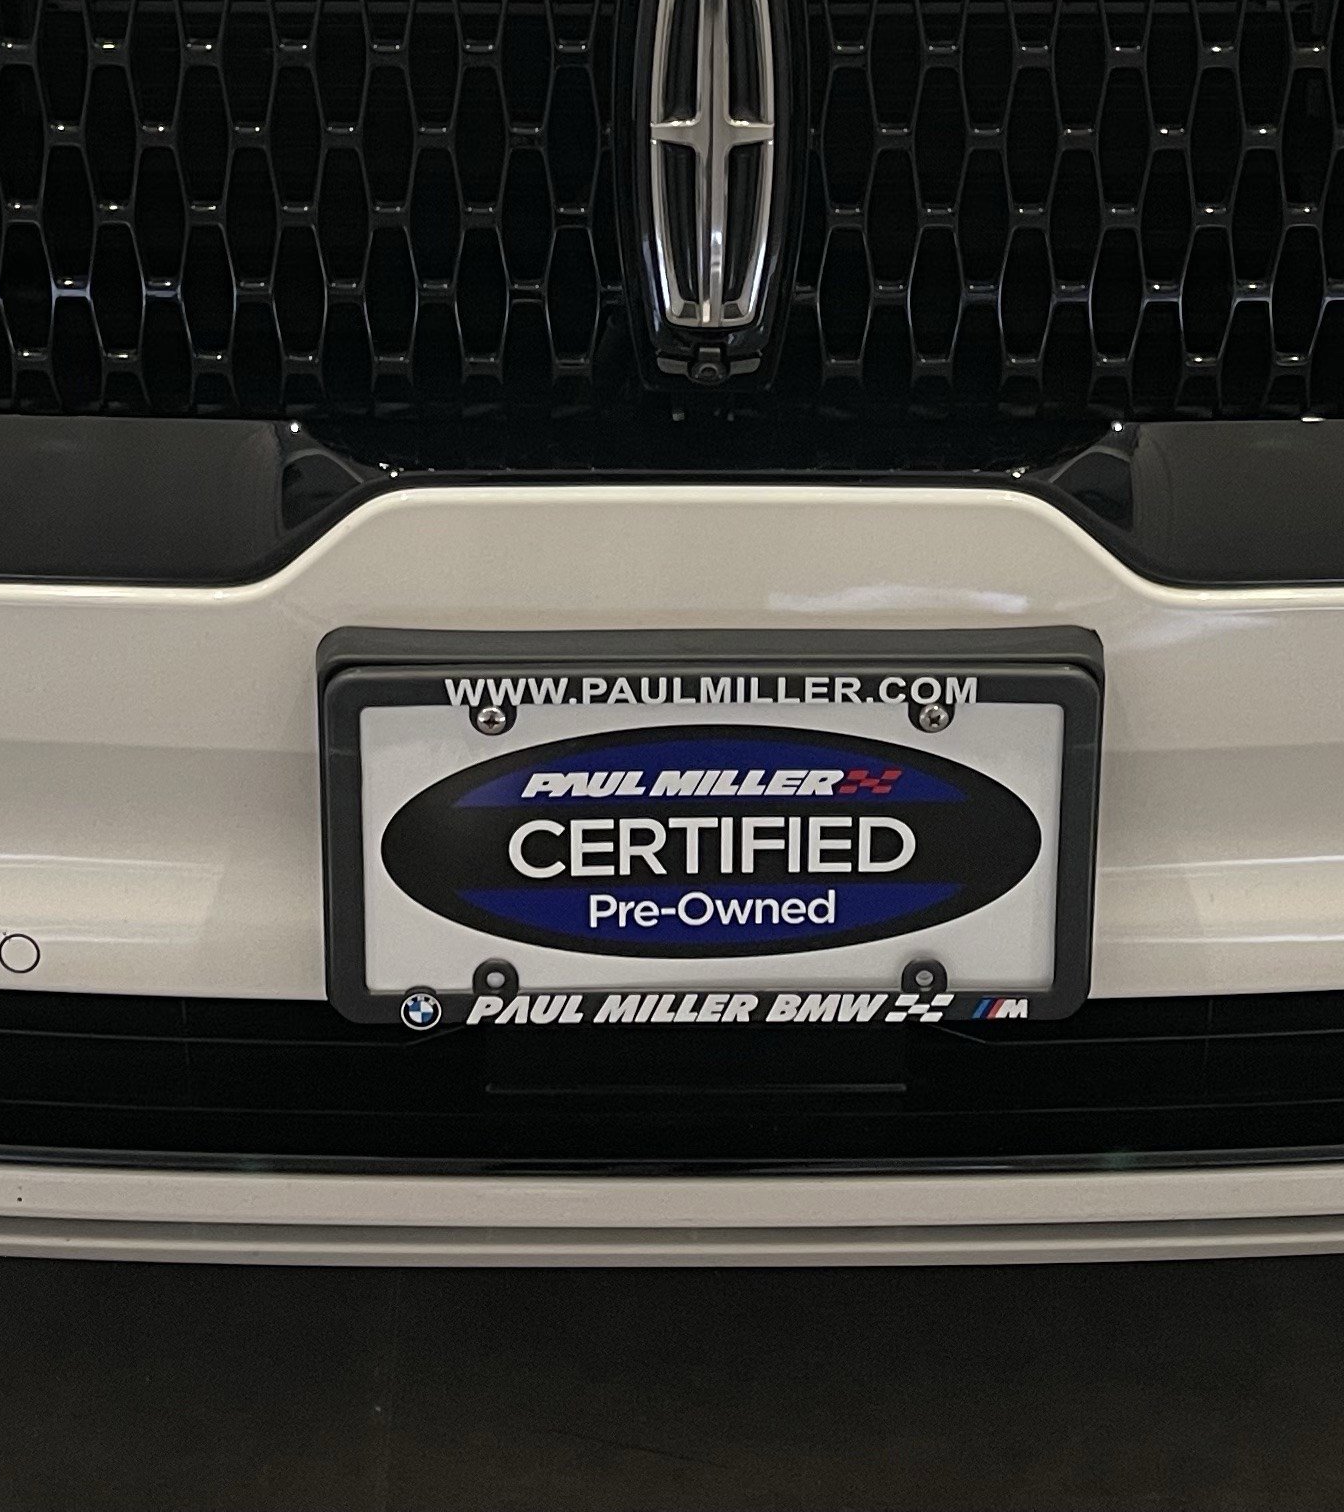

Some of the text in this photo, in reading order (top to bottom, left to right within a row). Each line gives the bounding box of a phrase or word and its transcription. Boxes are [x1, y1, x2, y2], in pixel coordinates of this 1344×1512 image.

[445, 676, 978, 706] WWW.PAULMILLER.COM
[522, 770, 845, 797] PAUL MILLER
[508, 816, 916, 878] CERTIFIED
[589, 890, 836, 928] Pre-Owned
[466, 995, 583, 1025] PAUL
[593, 994, 758, 1023] MILLER
[766, 994, 888, 1023] BMW
